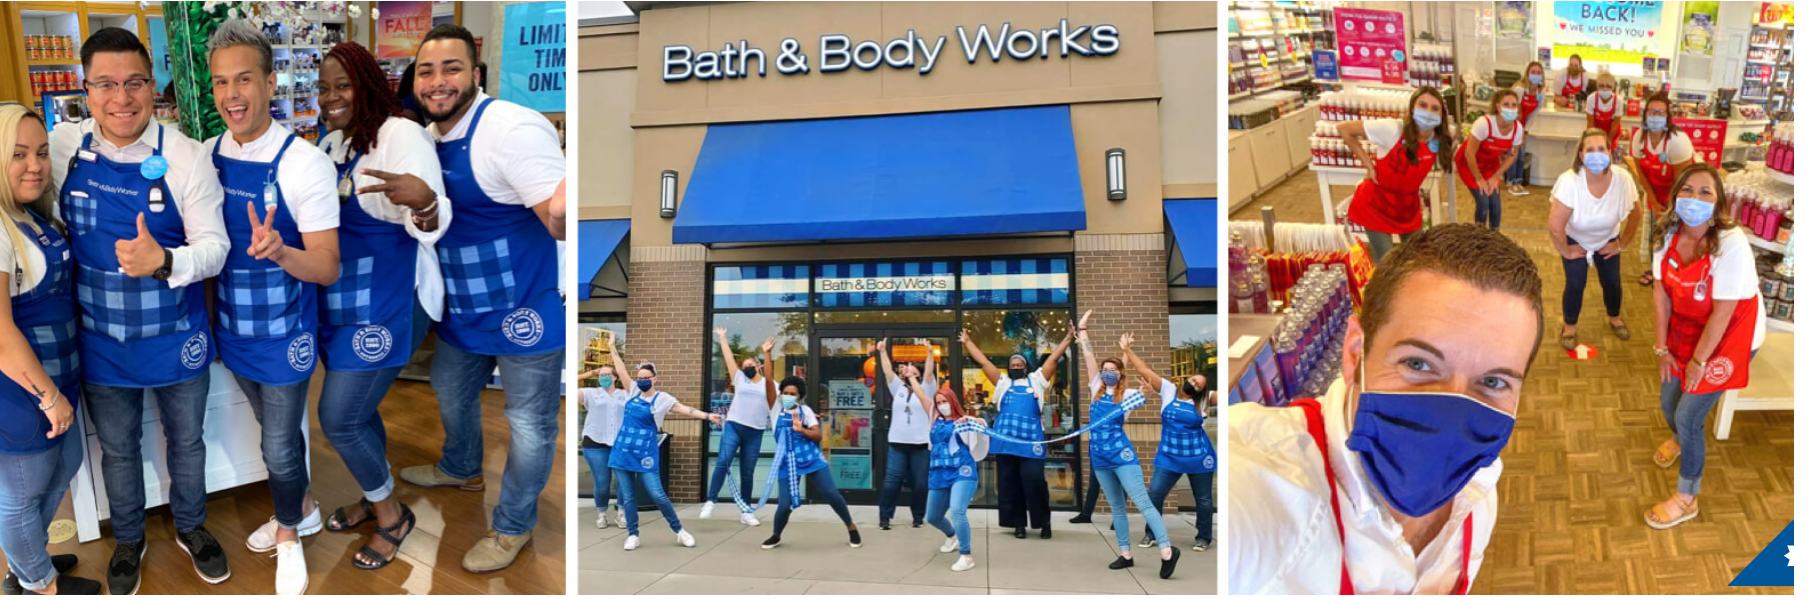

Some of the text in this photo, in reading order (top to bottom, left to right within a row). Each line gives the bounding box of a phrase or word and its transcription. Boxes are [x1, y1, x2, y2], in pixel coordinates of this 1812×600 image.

[1581, 3, 1637, 23] BACK!
[385, 17, 424, 34] FALL
[1569, 23, 1645, 38] WE MISSED YOU
[662, 18, 1120, 82] Bath & Body Works
[822, 277, 947, 292] Bath & Body Works
[836, 396, 865, 406] FREE
[840, 471, 862, 480] FREE
